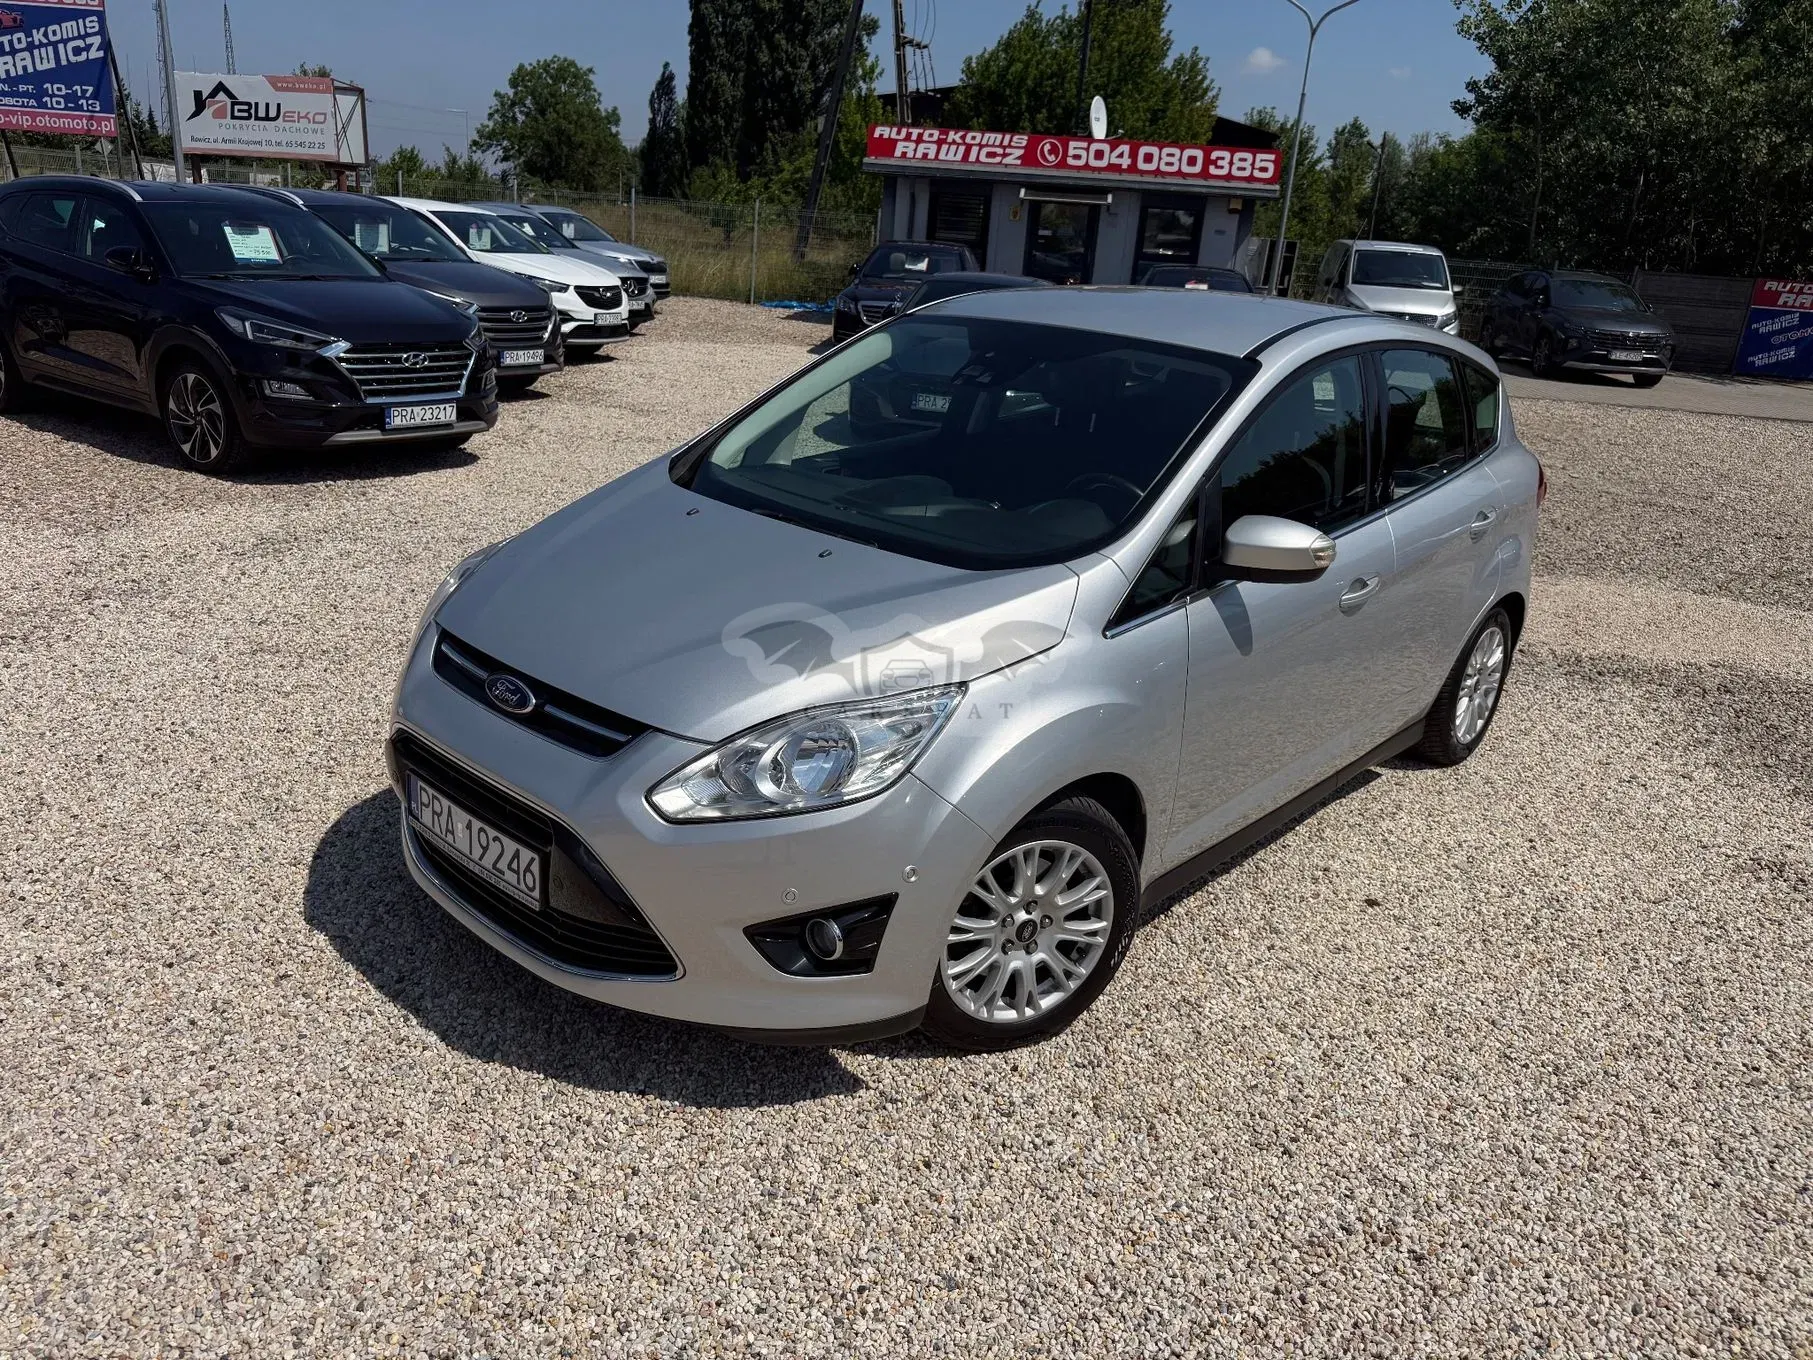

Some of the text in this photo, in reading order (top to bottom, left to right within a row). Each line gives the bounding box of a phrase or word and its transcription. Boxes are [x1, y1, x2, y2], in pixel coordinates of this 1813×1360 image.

[0, 35, 104, 79] RAWICZ
[43, 83, 94, 97] 10-17
[219, 123, 325, 136] POKRYCIA DACHOWE
[873, 126, 1029, 147] AUTO-KOMIS
[295, 141, 307, 149] 545
[317, 142, 326, 150] 25
[894, 141, 1027, 165] RAWICZ
[1066, 141, 1276, 179] 504 080 385
[1758, 318, 1800, 334] RAWICZ
[504, 352, 520, 362] PRA
[1754, 351, 1796, 367] RAWICZ
[392, 405, 455, 423] PRA 23217
[491, 679, 521, 706] Ford
[420, 784, 456, 844] PRA
[465, 818, 537, 893] 19246
